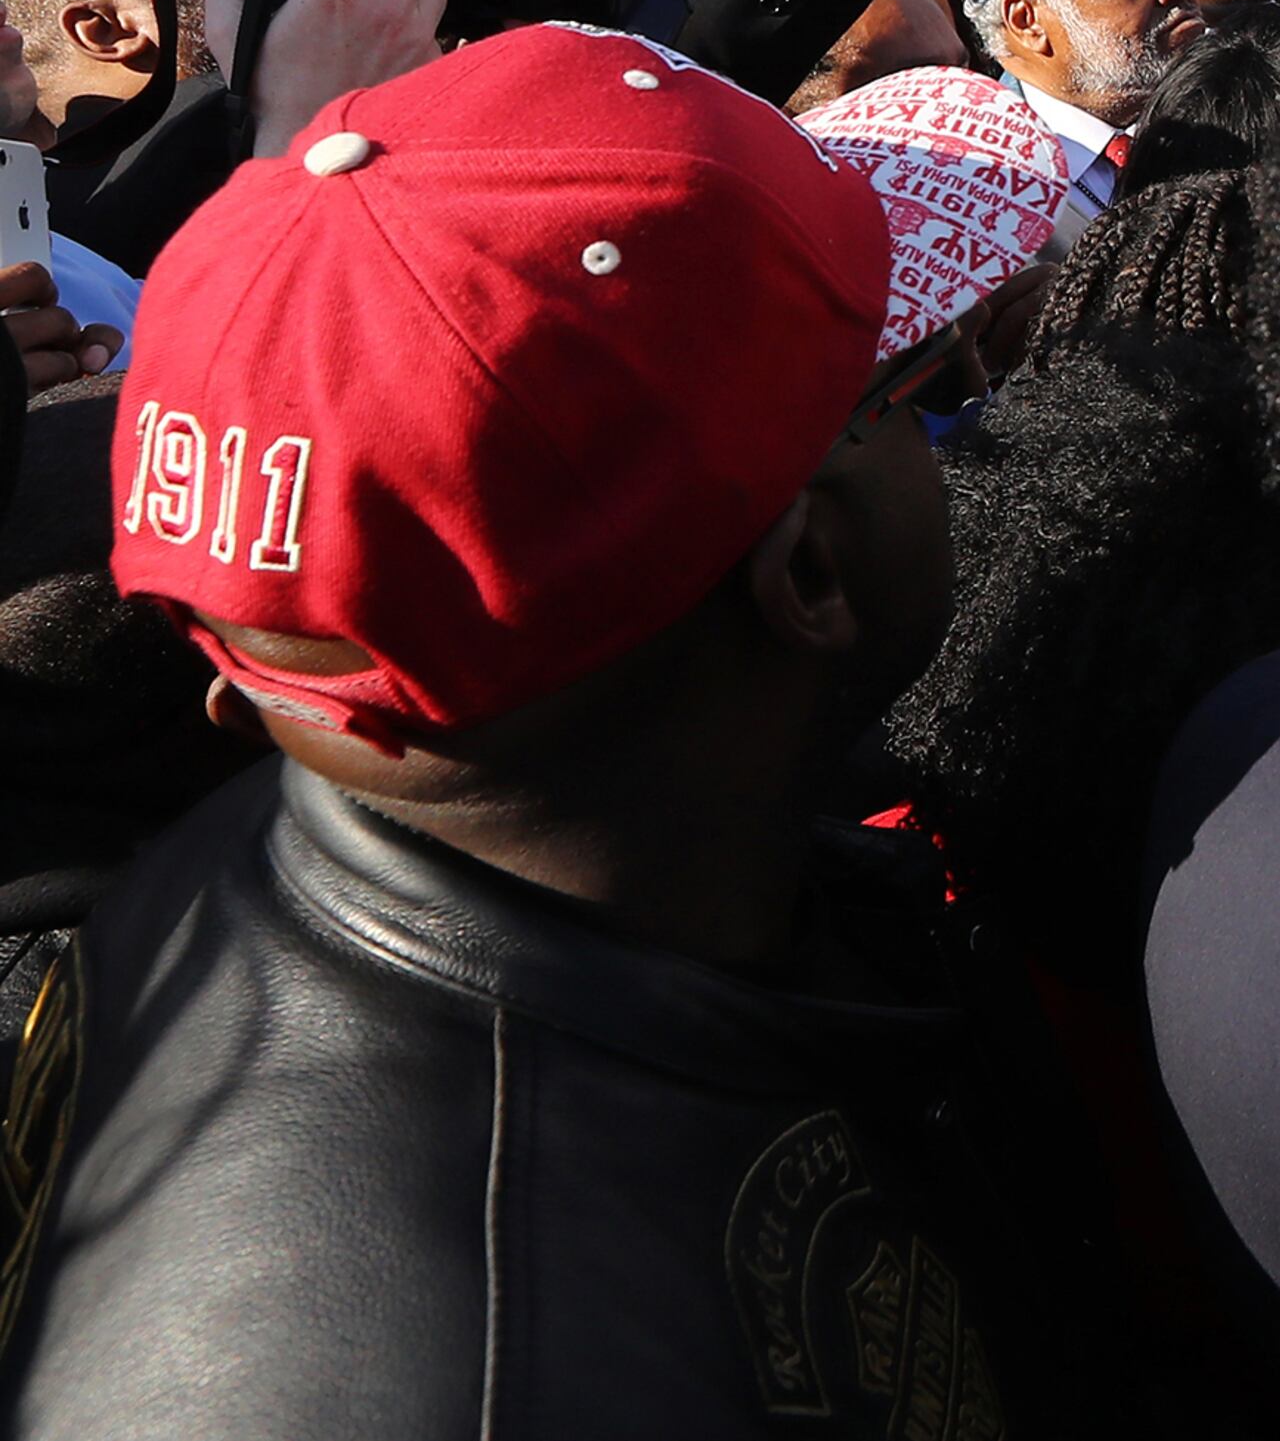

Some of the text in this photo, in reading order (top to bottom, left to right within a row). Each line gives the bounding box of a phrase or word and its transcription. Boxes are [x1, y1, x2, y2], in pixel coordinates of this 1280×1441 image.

[960, 104, 1003, 126] ALPHA
[951, 119, 1014, 150] 1911
[895, 159, 920, 175] PSI
[922, 164, 968, 191] ALPHA
[910, 180, 977, 220] 1911
[967, 180, 1013, 213] KAPPA
[890, 238, 970, 290] KAPPA ALPH
[890, 259, 934, 297] 19
[123, 400, 312, 573] 1911
[775, 1132, 850, 1209] City
